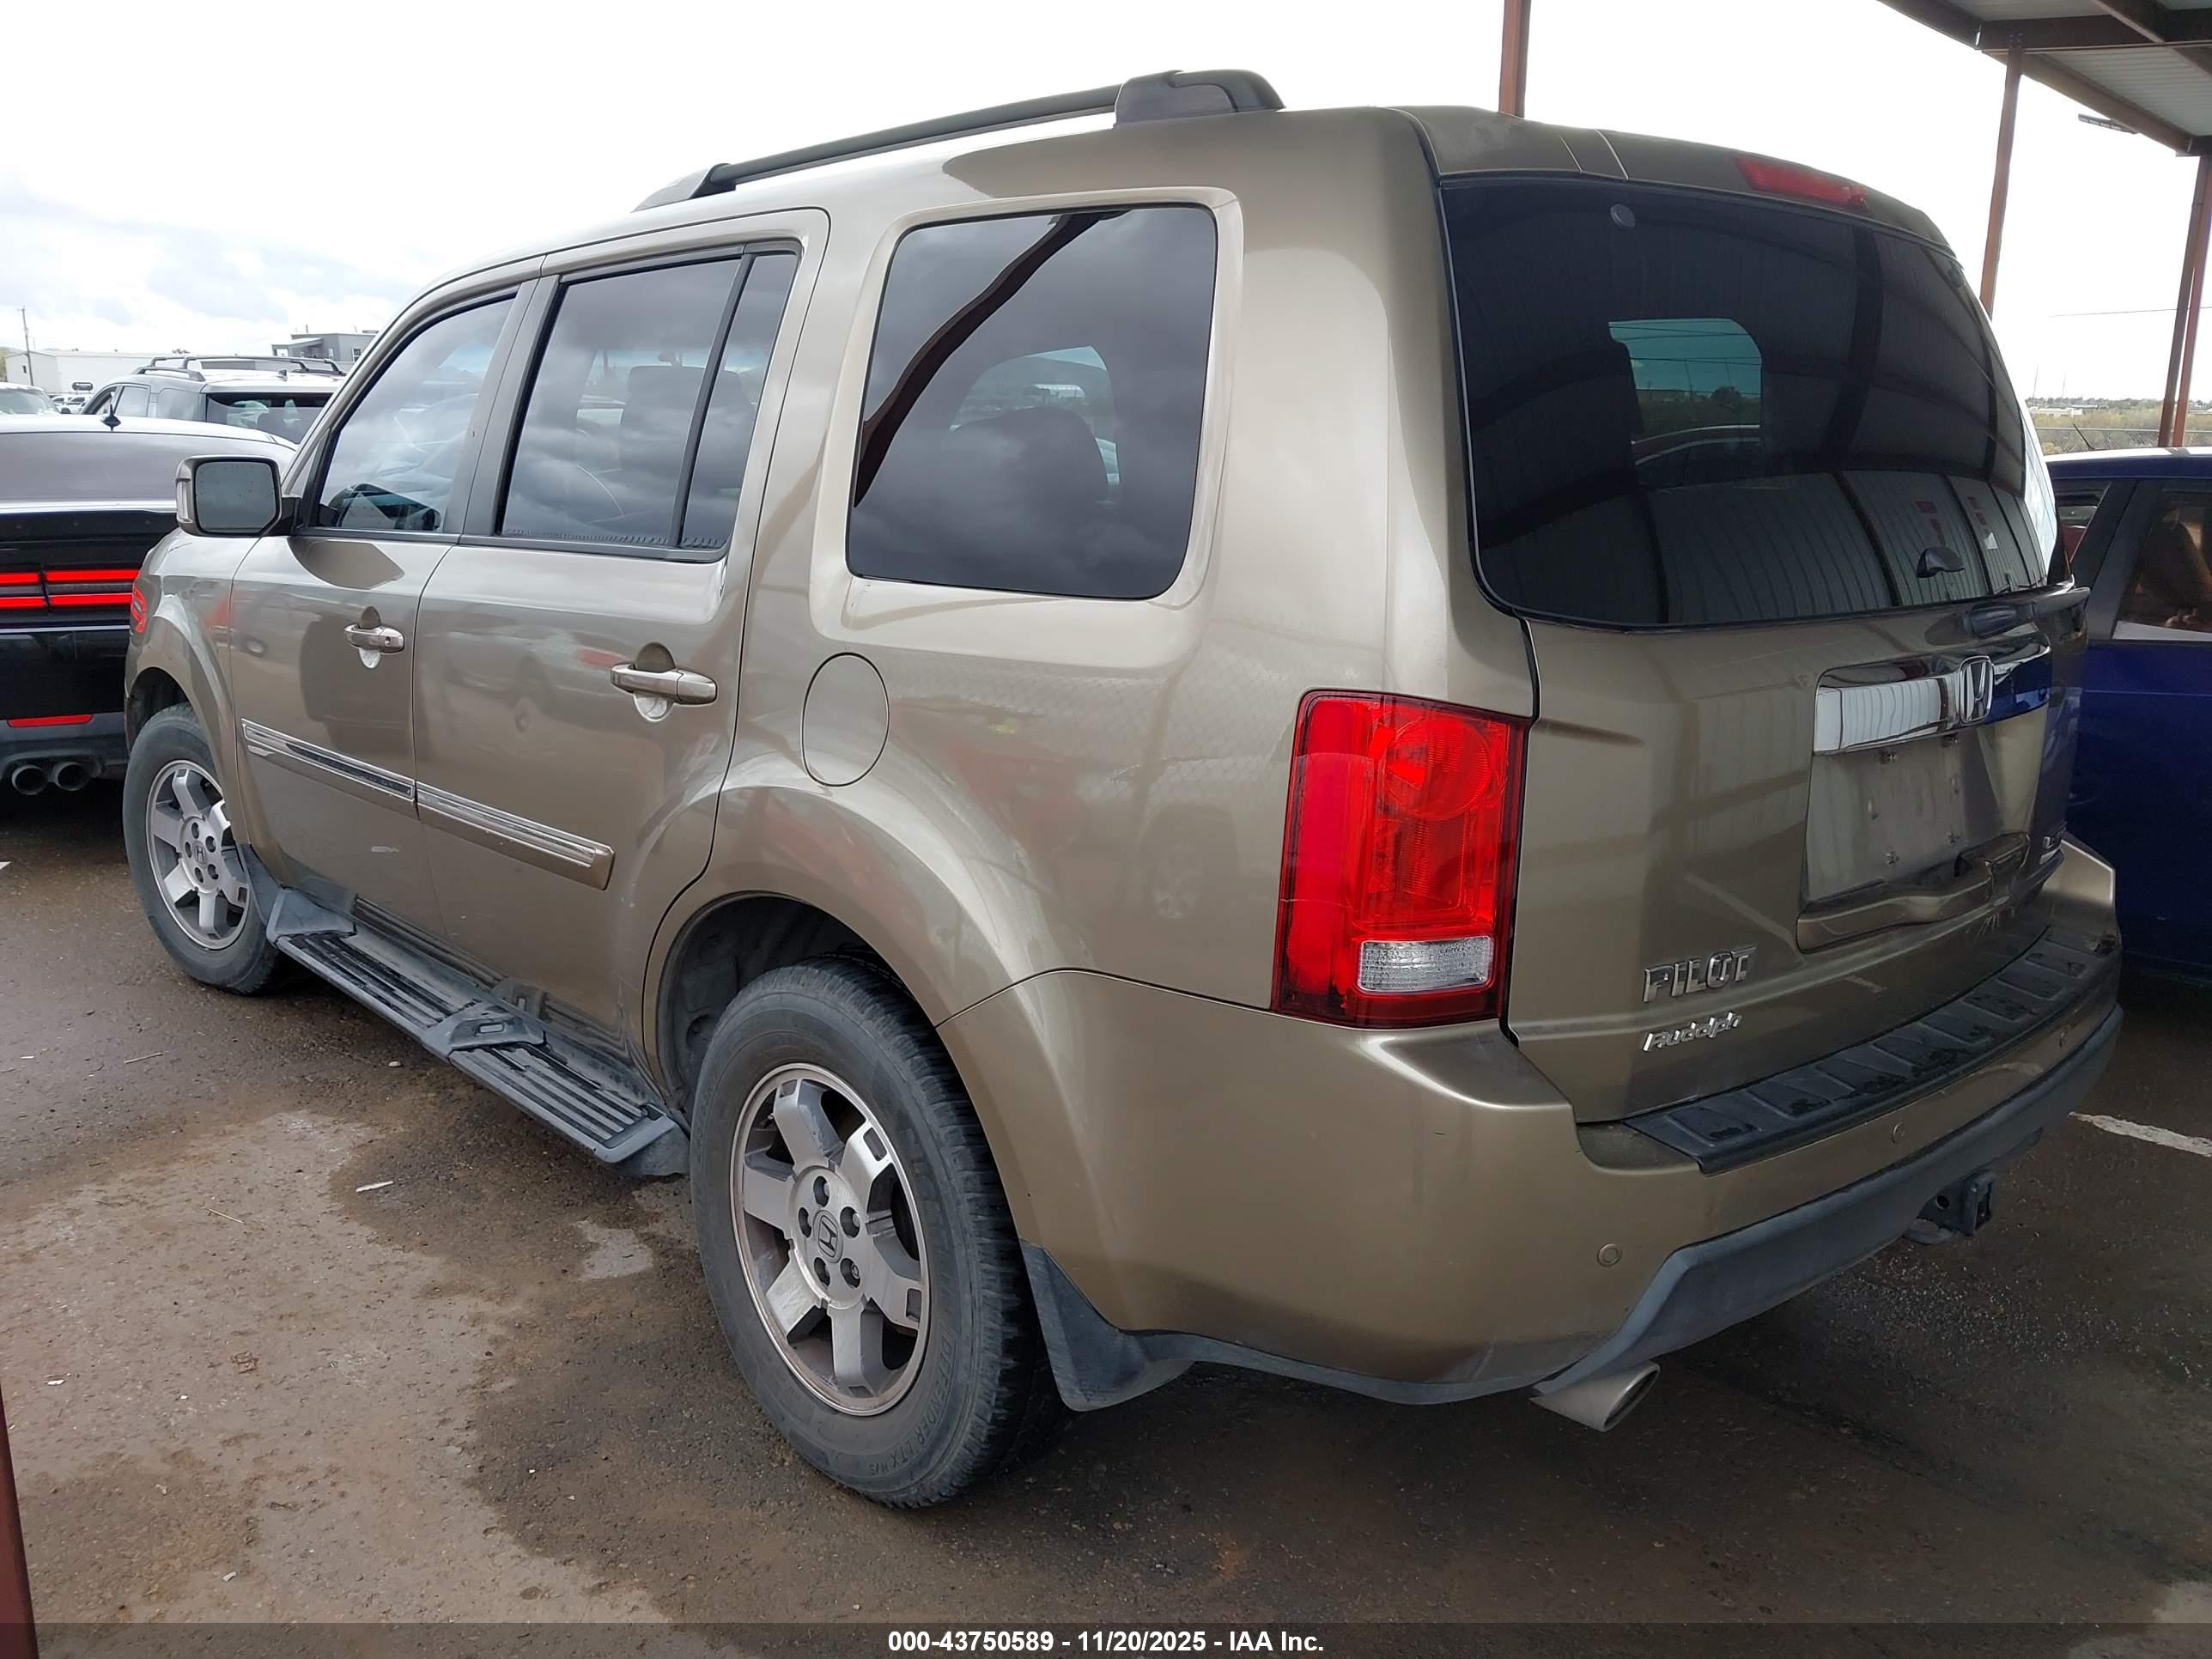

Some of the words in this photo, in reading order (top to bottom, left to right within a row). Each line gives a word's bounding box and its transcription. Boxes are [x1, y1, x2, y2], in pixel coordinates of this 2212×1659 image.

[1642, 946, 1757, 1003] PILOT
[1642, 1011, 1743, 1053] Rudolph
[914, 1334, 953, 1444] DEFENDER
